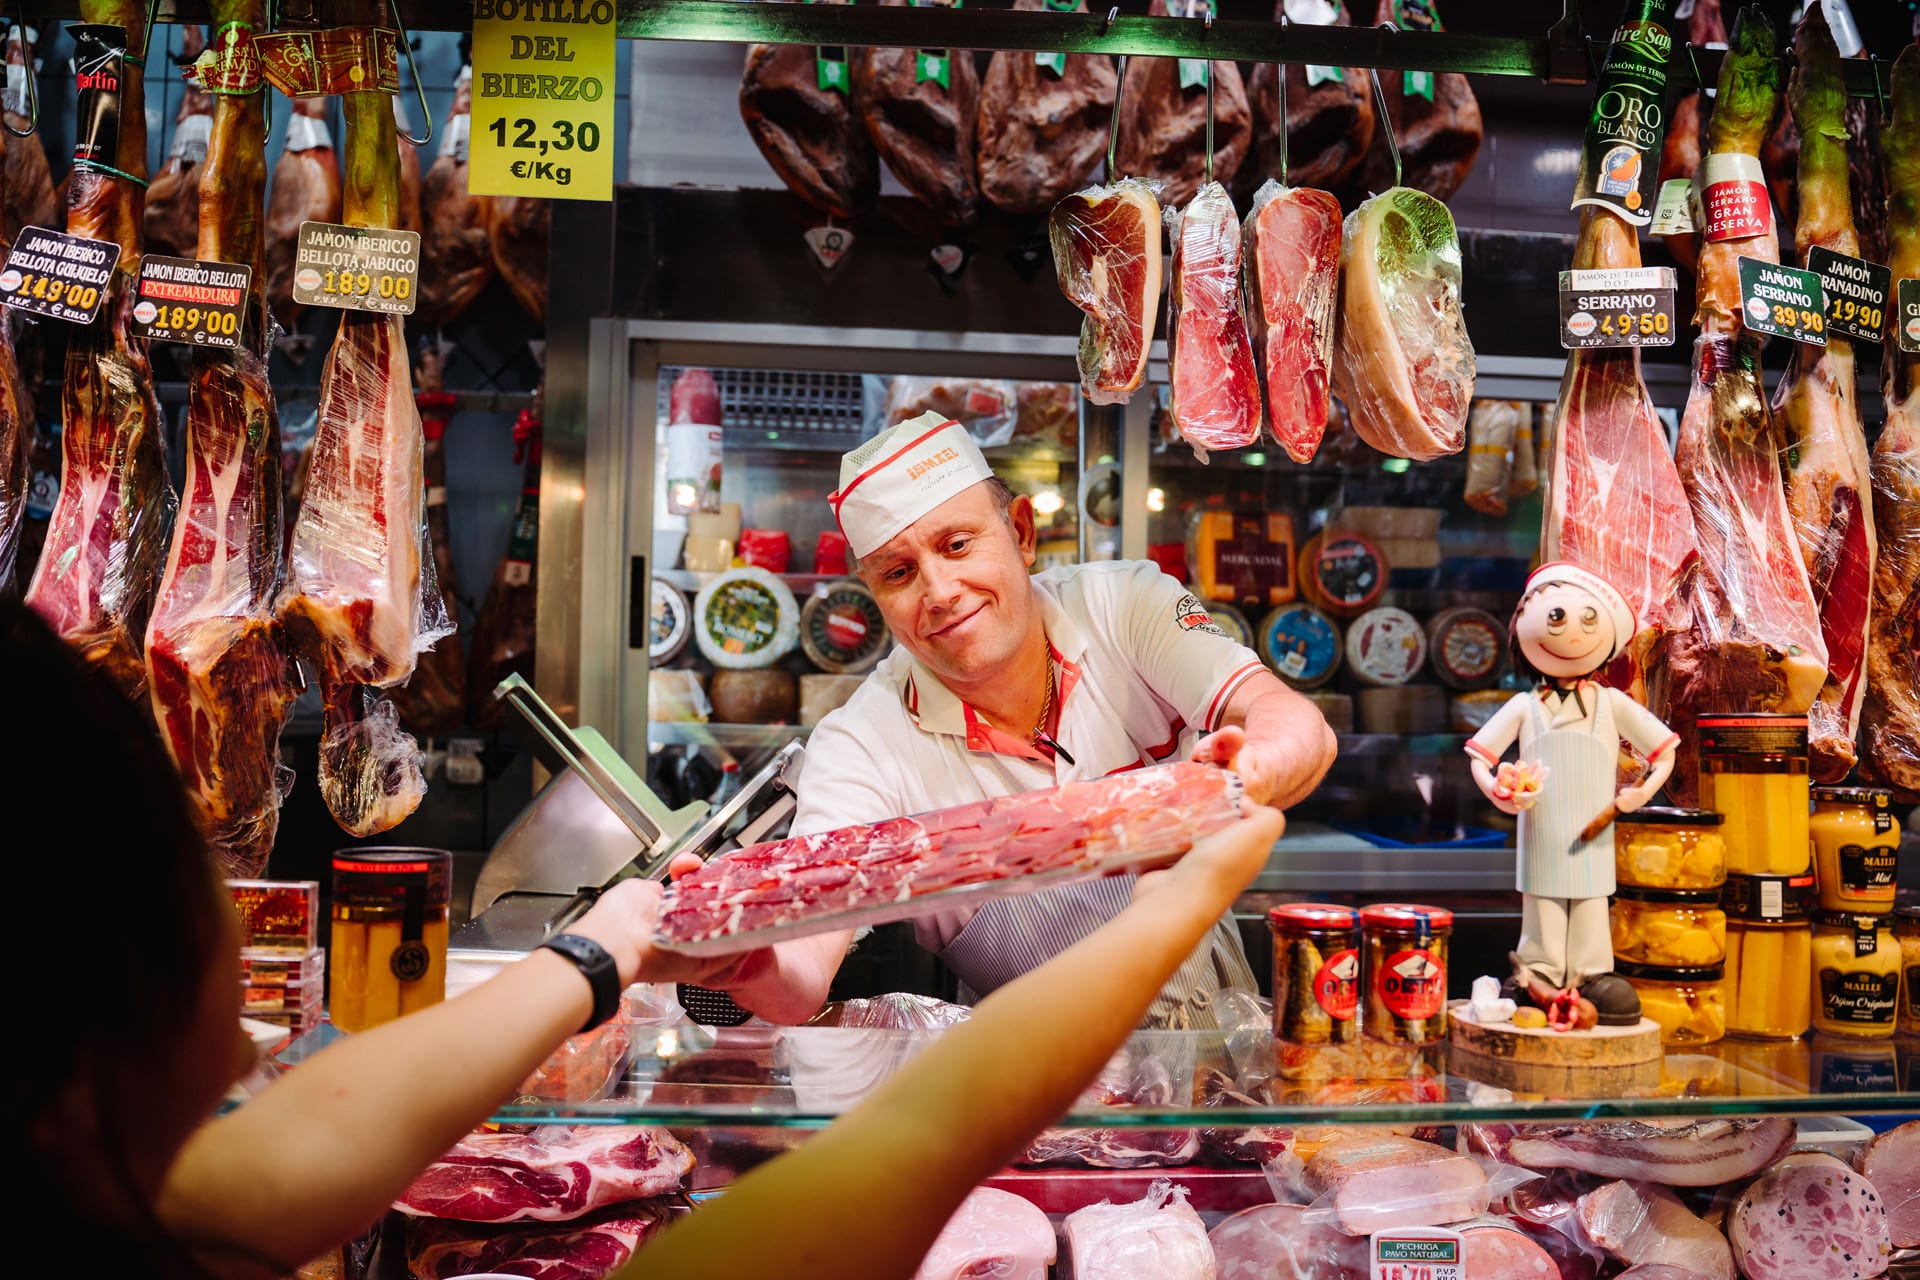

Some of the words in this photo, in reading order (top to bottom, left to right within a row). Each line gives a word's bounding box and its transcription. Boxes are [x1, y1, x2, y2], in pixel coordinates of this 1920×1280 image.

[474, 0, 614, 24] BOTILLO
[510, 35, 575, 62] DEL
[1636, 65, 1647, 73] DE
[481, 73, 603, 102] BIERZO
[1597, 91, 1661, 129] ORO
[489, 117, 600, 156] 12,30
[1597, 120, 1655, 144] BLANCO
[510, 161, 572, 185] €/Kg
[1710, 197, 1757, 209] SERRANO
[1714, 187, 1750, 198] JAMON
[1714, 207, 1752, 219] GRAN
[1707, 218, 1763, 235] RESERVA
[26, 236, 64, 257] JAMON
[64, 244, 106, 265] IBERICO
[307, 231, 355, 249] JAMON
[357, 236, 411, 254] IBERICO
[9, 251, 56, 273] BELLOTA
[56, 261, 109, 284] GUIJUELO
[299, 248, 358, 268] BELLOTA
[361, 255, 415, 273] JABUGO
[142, 263, 174, 281] JAMON
[173, 266, 209, 284] IBERICO
[209, 270, 247, 289] BELLOTA
[1759, 269, 1803, 290] JAMON
[1828, 261, 1871, 284] JAMON
[144, 281, 236, 302] EXTREMADURA
[1753, 283, 1812, 308] SERRANO
[1821, 275, 1883, 304] RANADINO
[51, 304, 63, 315] €
[365, 297, 378, 309] €
[1578, 294, 1656, 311] SERRANO
[147, 327, 172, 338] P.V.P.
[194, 331, 206, 343] €
[1628, 334, 1639, 345] €
[1794, 328, 1803, 339] €
[1849, 323, 1857, 334] €
